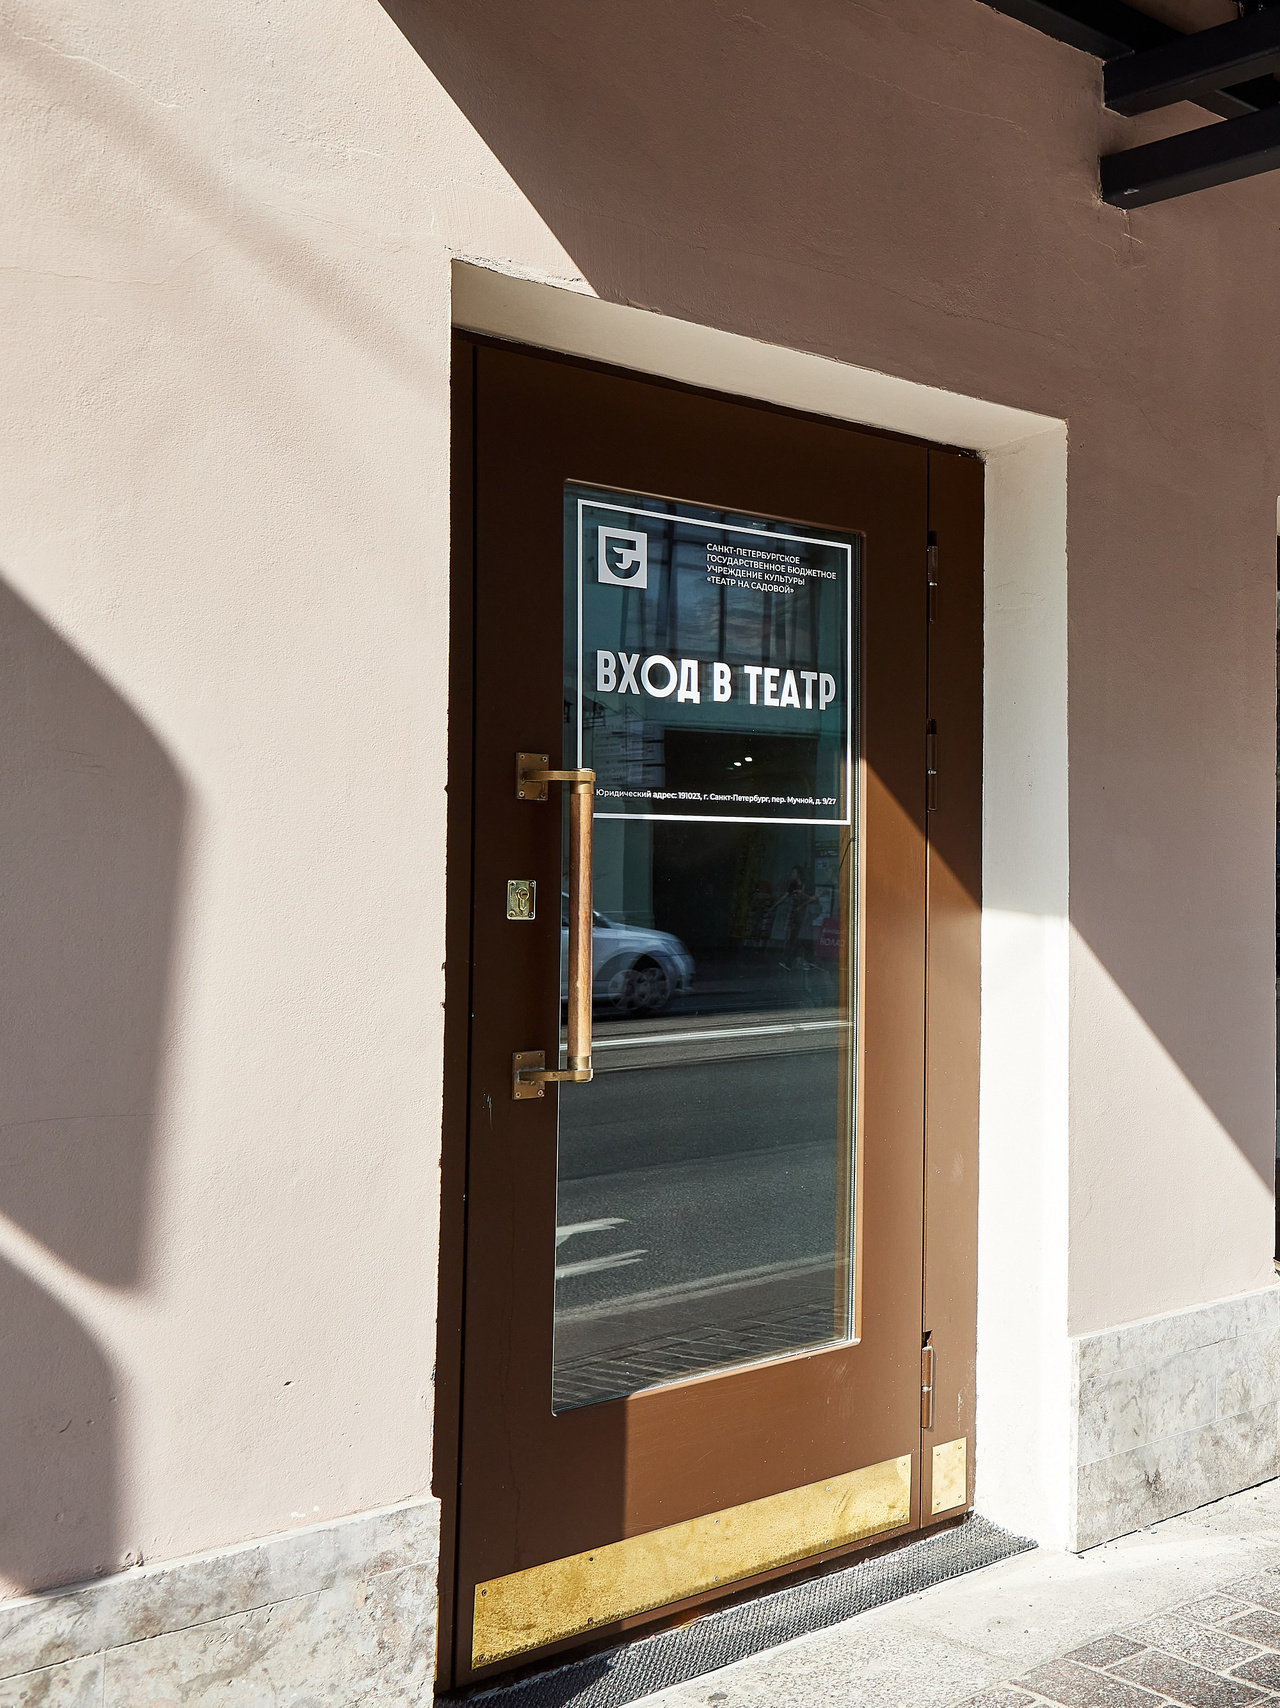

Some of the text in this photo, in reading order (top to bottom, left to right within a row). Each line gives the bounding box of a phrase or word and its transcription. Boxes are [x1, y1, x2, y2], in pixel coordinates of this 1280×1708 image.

[706, 543, 800, 565] САНКТ-ПЕТЕРБУРГСКОЕ
[706, 553, 837, 580] ГОСУДАРСТВЕННОЕ БЮДЖЕТНОЕ
[706, 564, 805, 586] УЧРЕЖДЕНИЕ КУЛЬТУРЫ
[706, 575, 795, 595] «ТЕАТР НА САДОВОЙ»
[597, 649, 836, 711] ВХОД В ТЕАТР
[595, 788, 652, 798] Юридический
[652, 791, 678, 800] адрес:
[678, 791, 702, 801] 191023,
[703, 793, 709, 801] г.
[709, 793, 771, 804] Санкт-Петербург,
[771, 796, 787, 805] пер.
[787, 796, 815, 806] Мучной,
[822, 797, 837, 806] 9/27
